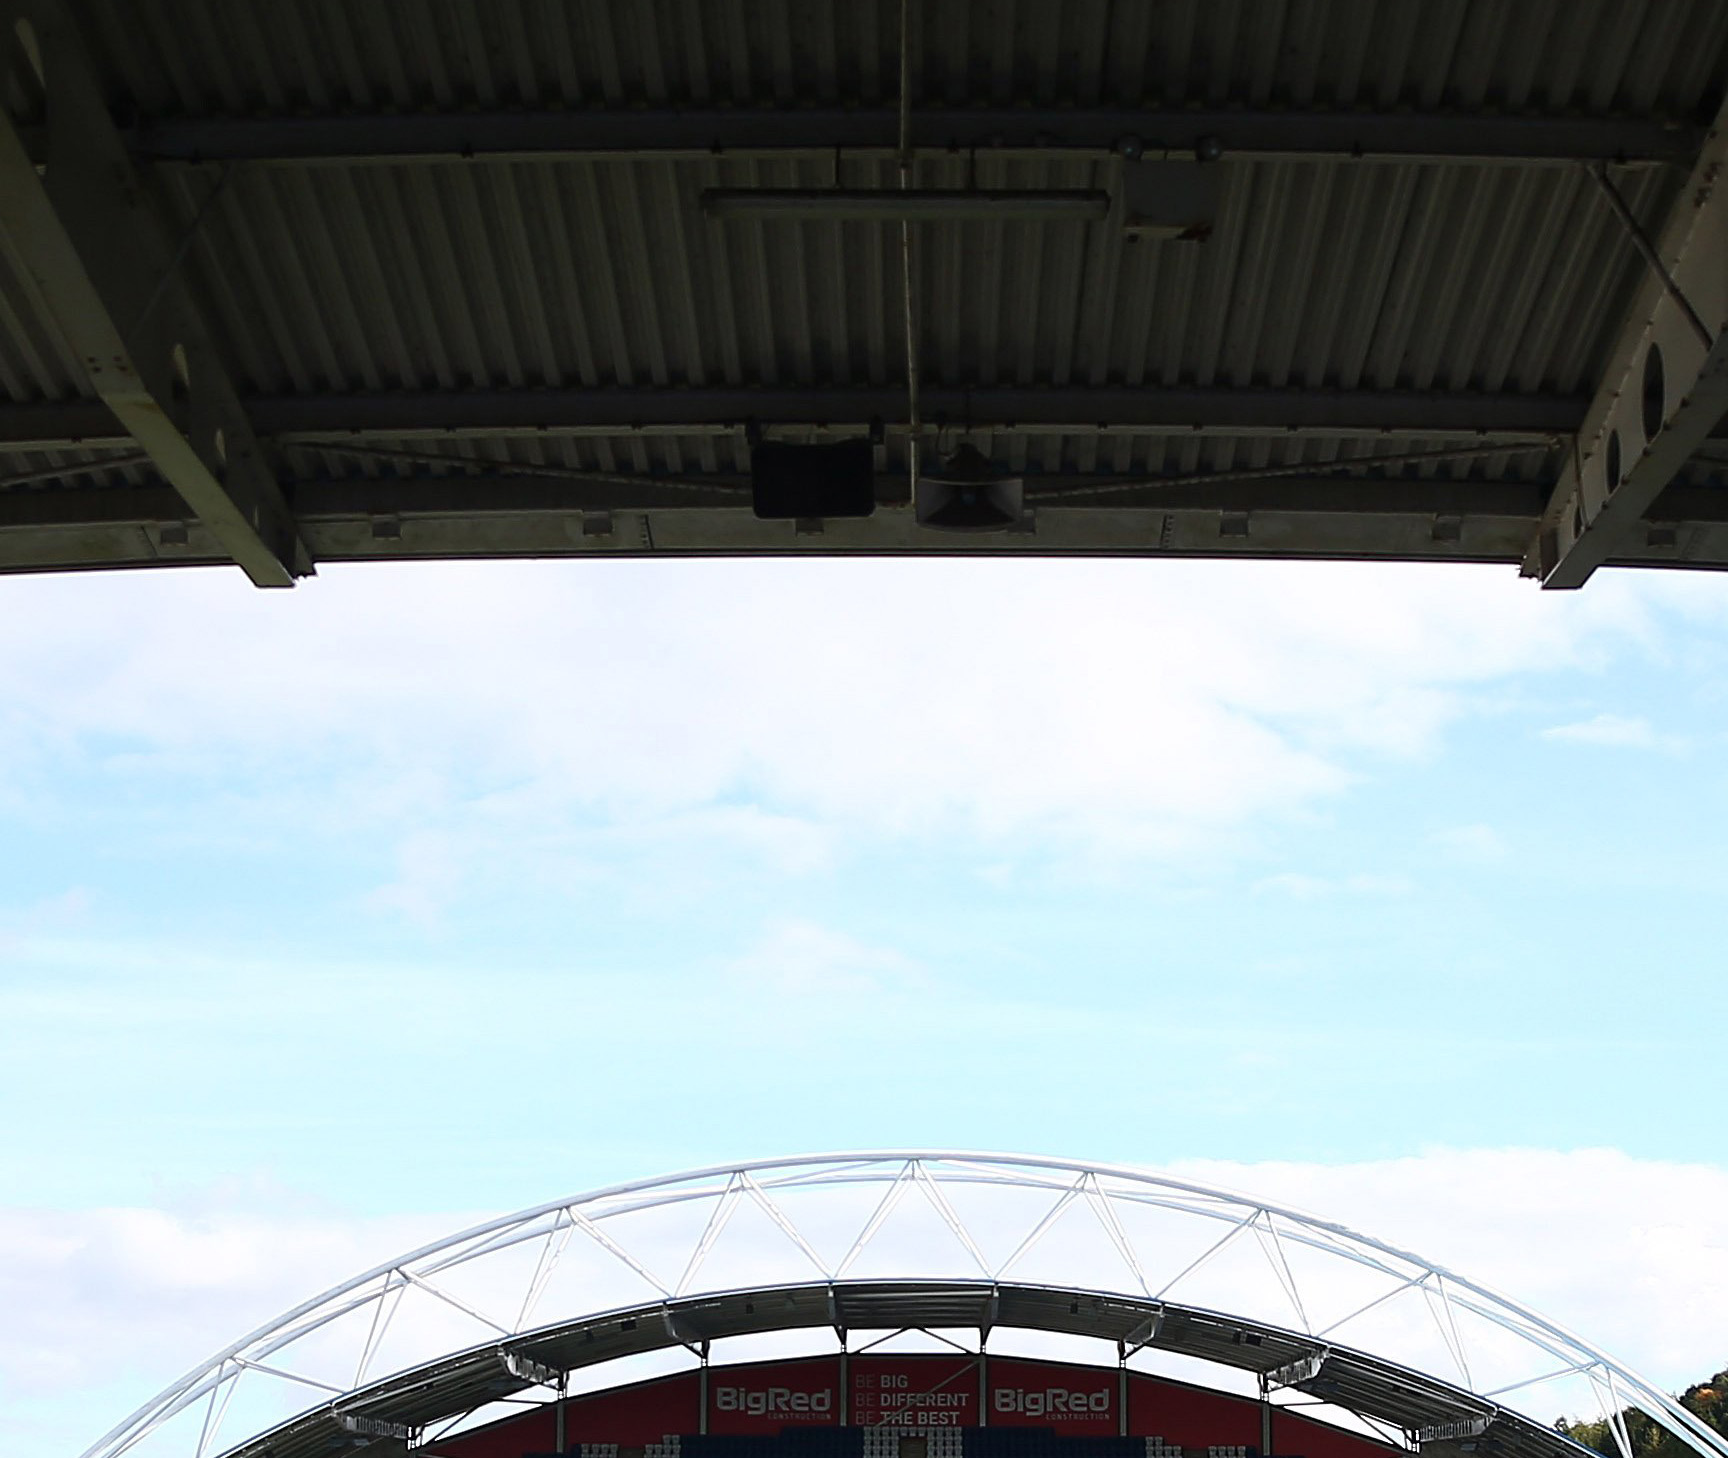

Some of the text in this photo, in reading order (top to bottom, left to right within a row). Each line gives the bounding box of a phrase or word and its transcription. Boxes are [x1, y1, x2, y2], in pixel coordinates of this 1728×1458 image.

[856, 1375, 908, 1388] BE BIG
[716, 1387, 831, 1415] BigRed
[856, 1393, 970, 1407] BE DIFFERENT
[995, 1388, 1110, 1416] BigRed
[856, 1412, 960, 1425] BE THE BEST
